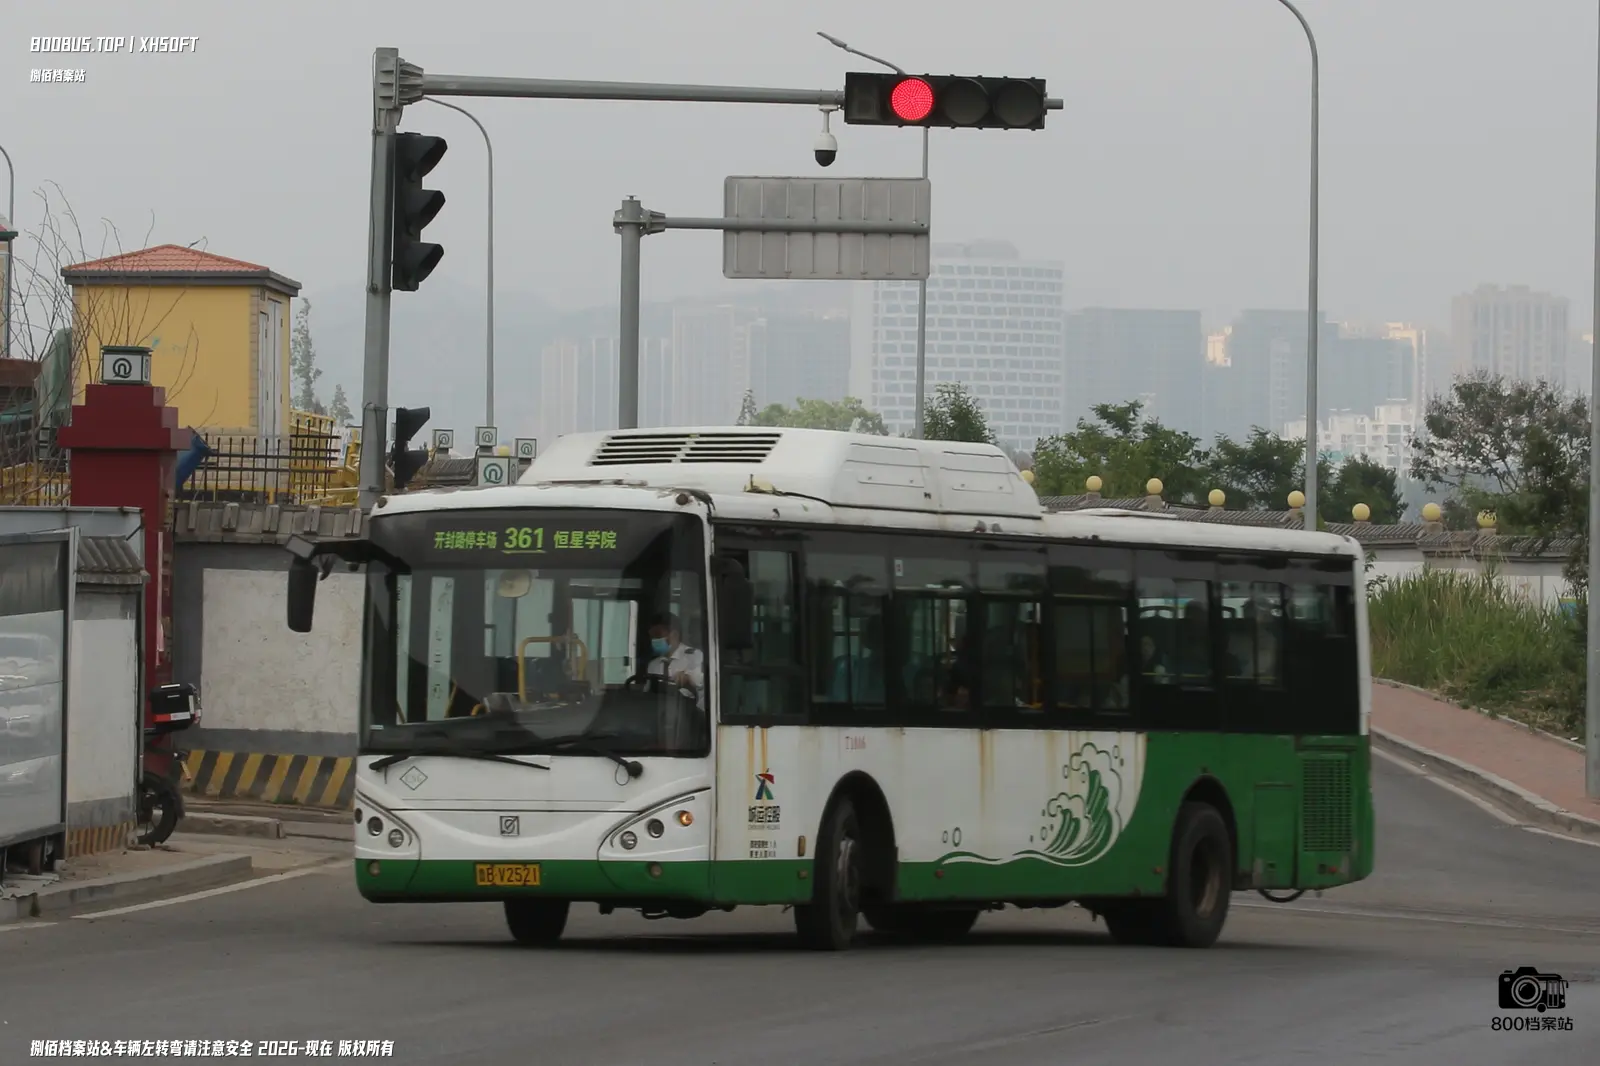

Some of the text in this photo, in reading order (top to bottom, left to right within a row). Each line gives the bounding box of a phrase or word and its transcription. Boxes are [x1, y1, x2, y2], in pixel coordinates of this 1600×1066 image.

[504, 527, 544, 549] 361
[553, 530, 617, 549] 恒星学院
